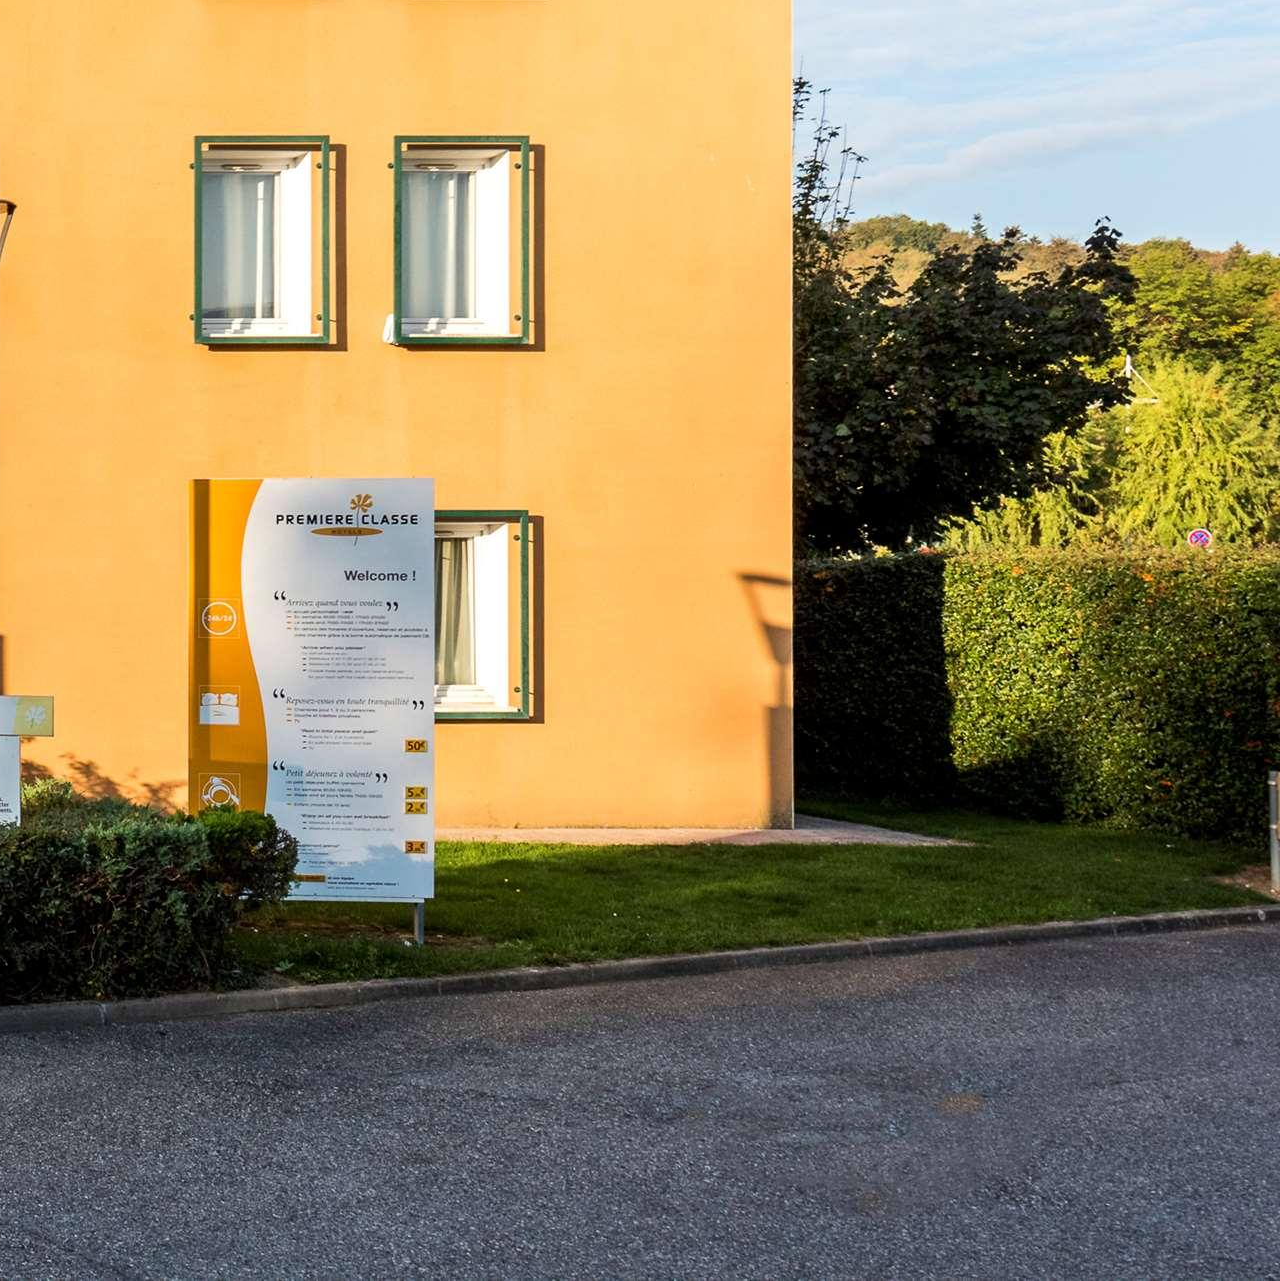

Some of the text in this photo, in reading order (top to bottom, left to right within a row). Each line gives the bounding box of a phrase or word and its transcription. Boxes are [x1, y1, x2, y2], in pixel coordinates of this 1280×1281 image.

[276, 514, 419, 525] PREMIERE CLASSE
[344, 570, 408, 581] Welcome
[286, 769, 304, 777] Petit
